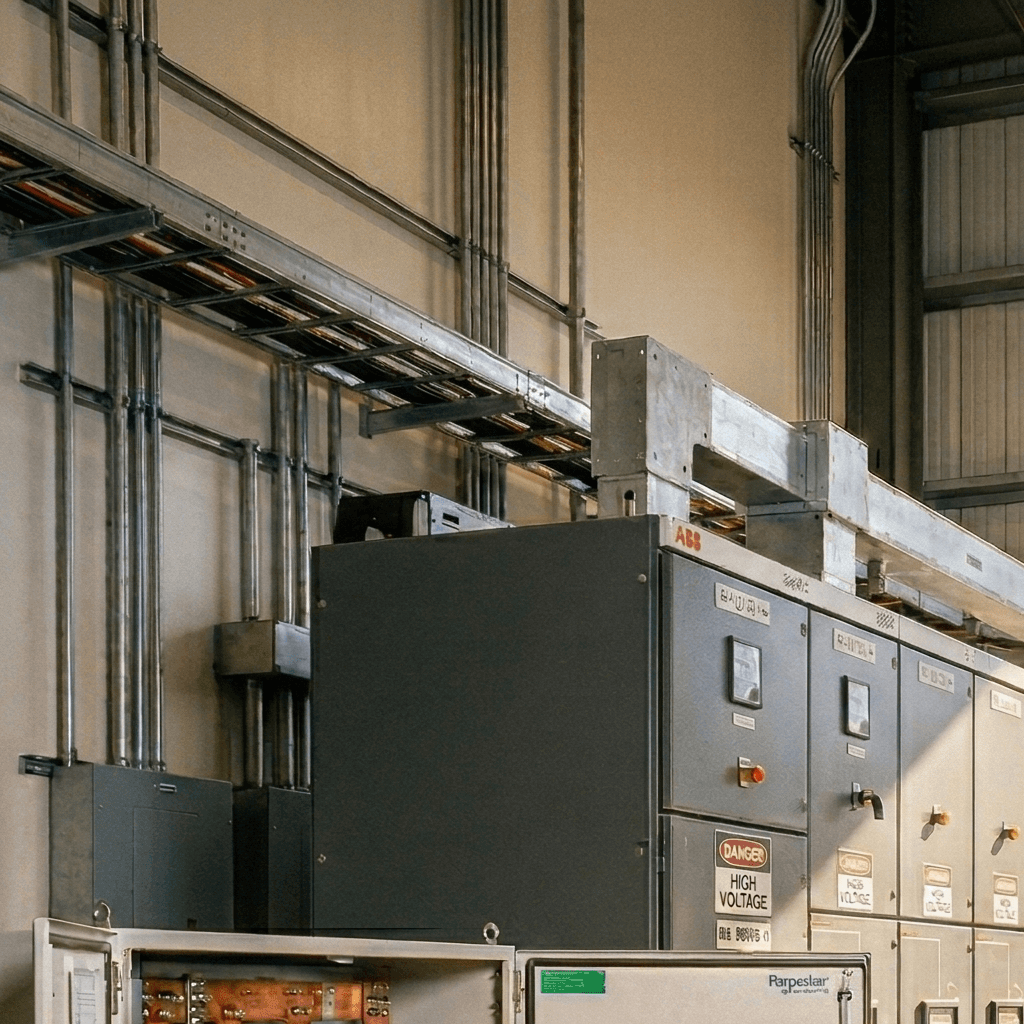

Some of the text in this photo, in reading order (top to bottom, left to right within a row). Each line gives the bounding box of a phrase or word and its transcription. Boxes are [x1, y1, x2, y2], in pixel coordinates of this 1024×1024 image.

[675, 525, 701, 551] ABB
[723, 843, 765, 863] DANGER
[730, 873, 757, 891] HIGH
[719, 891, 768, 910] VOLTAGE
